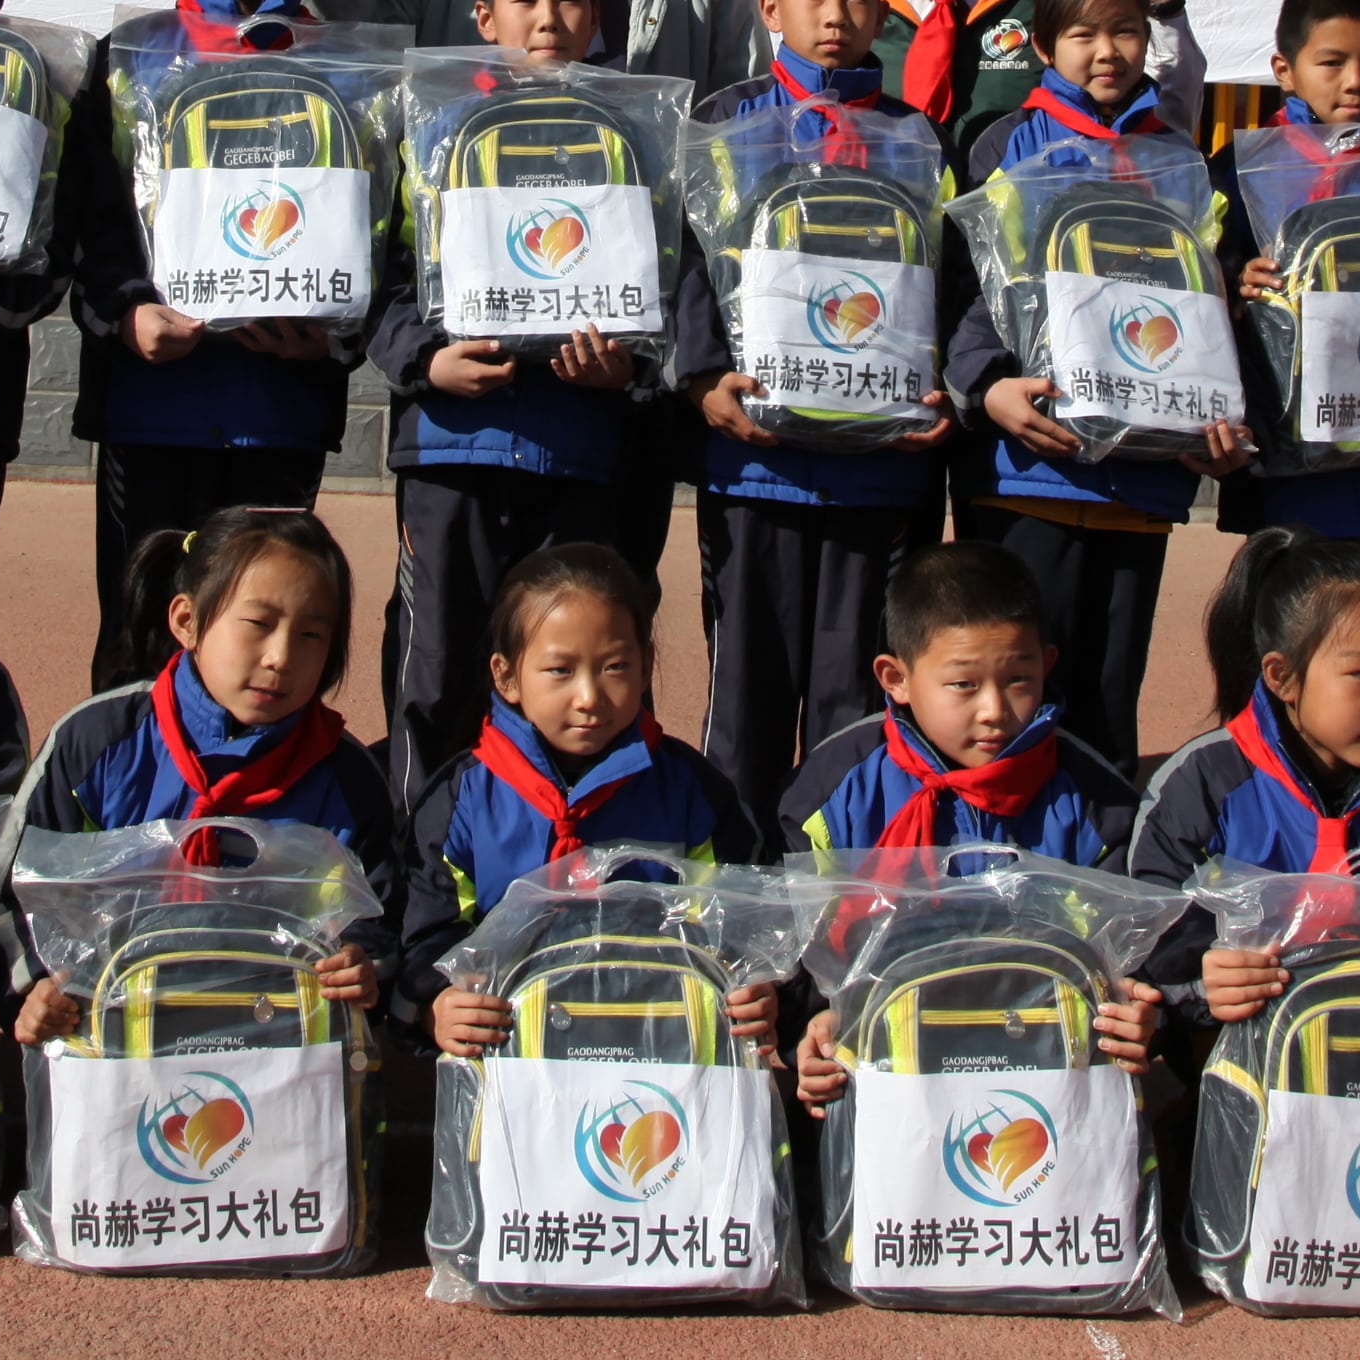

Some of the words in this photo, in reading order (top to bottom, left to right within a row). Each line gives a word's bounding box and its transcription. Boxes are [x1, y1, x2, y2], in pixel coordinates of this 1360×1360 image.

[223, 148, 296, 166] GEGEBAOBEI
[167, 268, 354, 306] 尚赫学习大礼包
[459, 283, 645, 322] 尚赫学习大礼包
[755, 354, 922, 404] 尚赫学习大礼包
[1070, 367, 1230, 422] 尚赫学习大礼包
[209, 1162, 231, 1179] SUN
[229, 1136, 252, 1163] HOPE
[643, 1181, 664, 1199] SUN
[662, 1155, 686, 1184] HOPE
[1013, 1185, 1034, 1203] SUN
[1032, 1160, 1056, 1187] HOPE
[71, 1187, 324, 1248] 尚赫学习大礼包
[498, 1209, 753, 1269] 尚赫学习大礼包
[874, 1213, 1124, 1269] 尚赫学习大礼包
